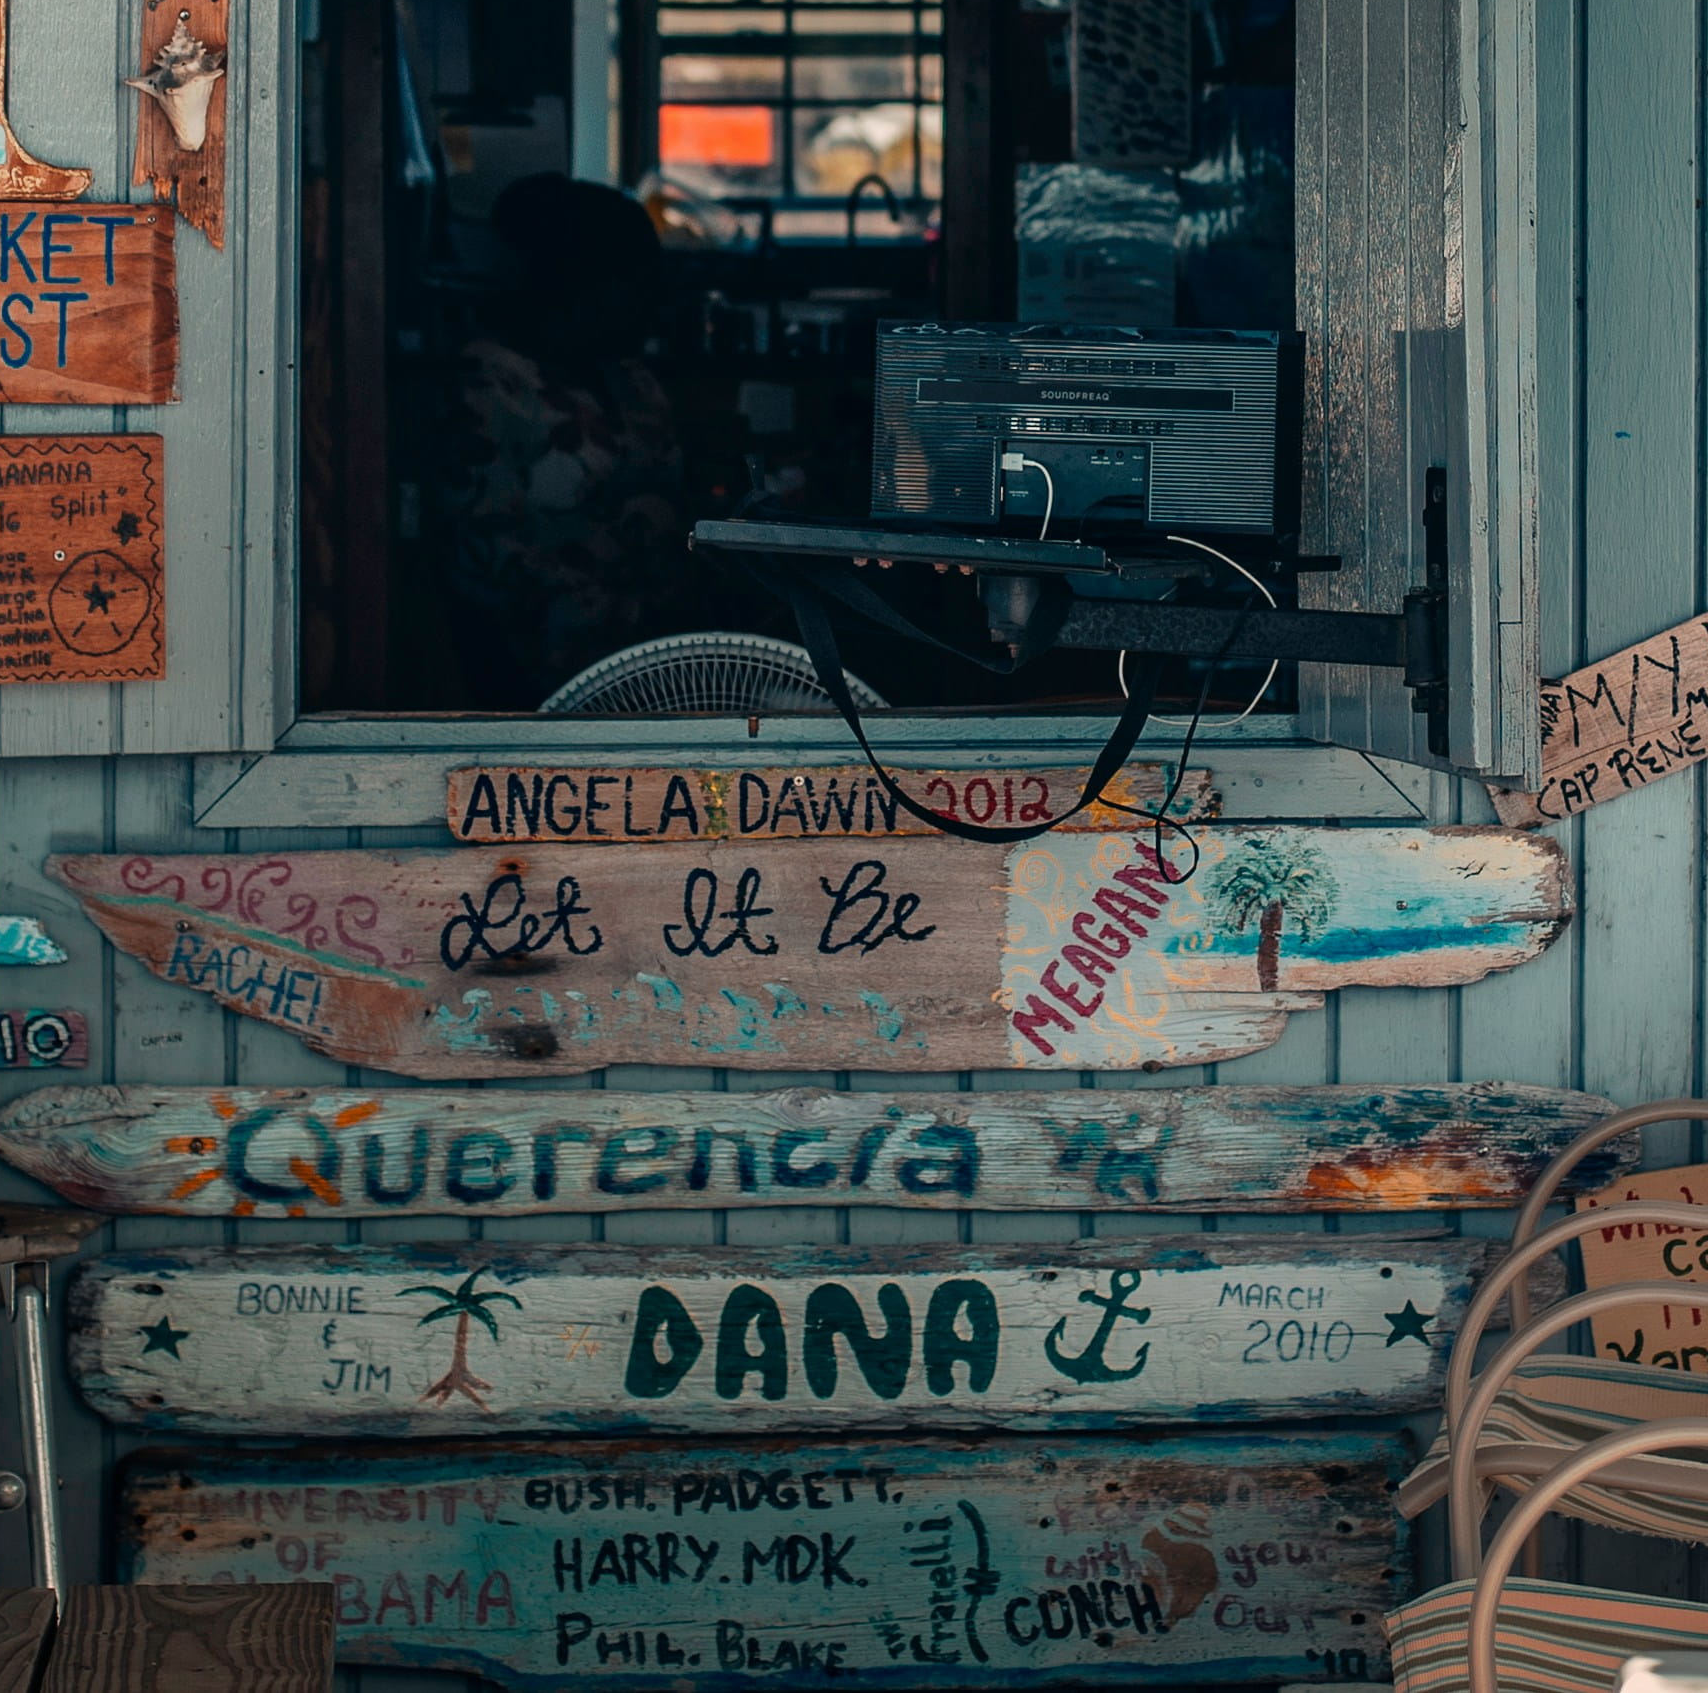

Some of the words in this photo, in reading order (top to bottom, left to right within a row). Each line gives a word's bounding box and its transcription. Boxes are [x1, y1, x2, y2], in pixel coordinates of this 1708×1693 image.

[460, 772, 700, 837] ANGELA
[737, 770, 900, 835] DAWN
[925, 775, 1056, 827] 2012
[439, 873, 604, 973] Let
[664, 865, 781, 958] It
[816, 859, 939, 958] Be
[1009, 838, 1182, 1057] MEAGAN
[227, 1104, 982, 1208] Querencia
[237, 1281, 368, 1316] BONNIE
[1217, 1280, 1326, 1310] MARCH
[624, 1276, 1003, 1401] DANA
[1242, 1318, 1355, 1365] 2010
[321, 1357, 392, 1393] JIM
[274, 1533, 347, 1575] OF
[1003, 1578, 1172, 1648] CONCH
